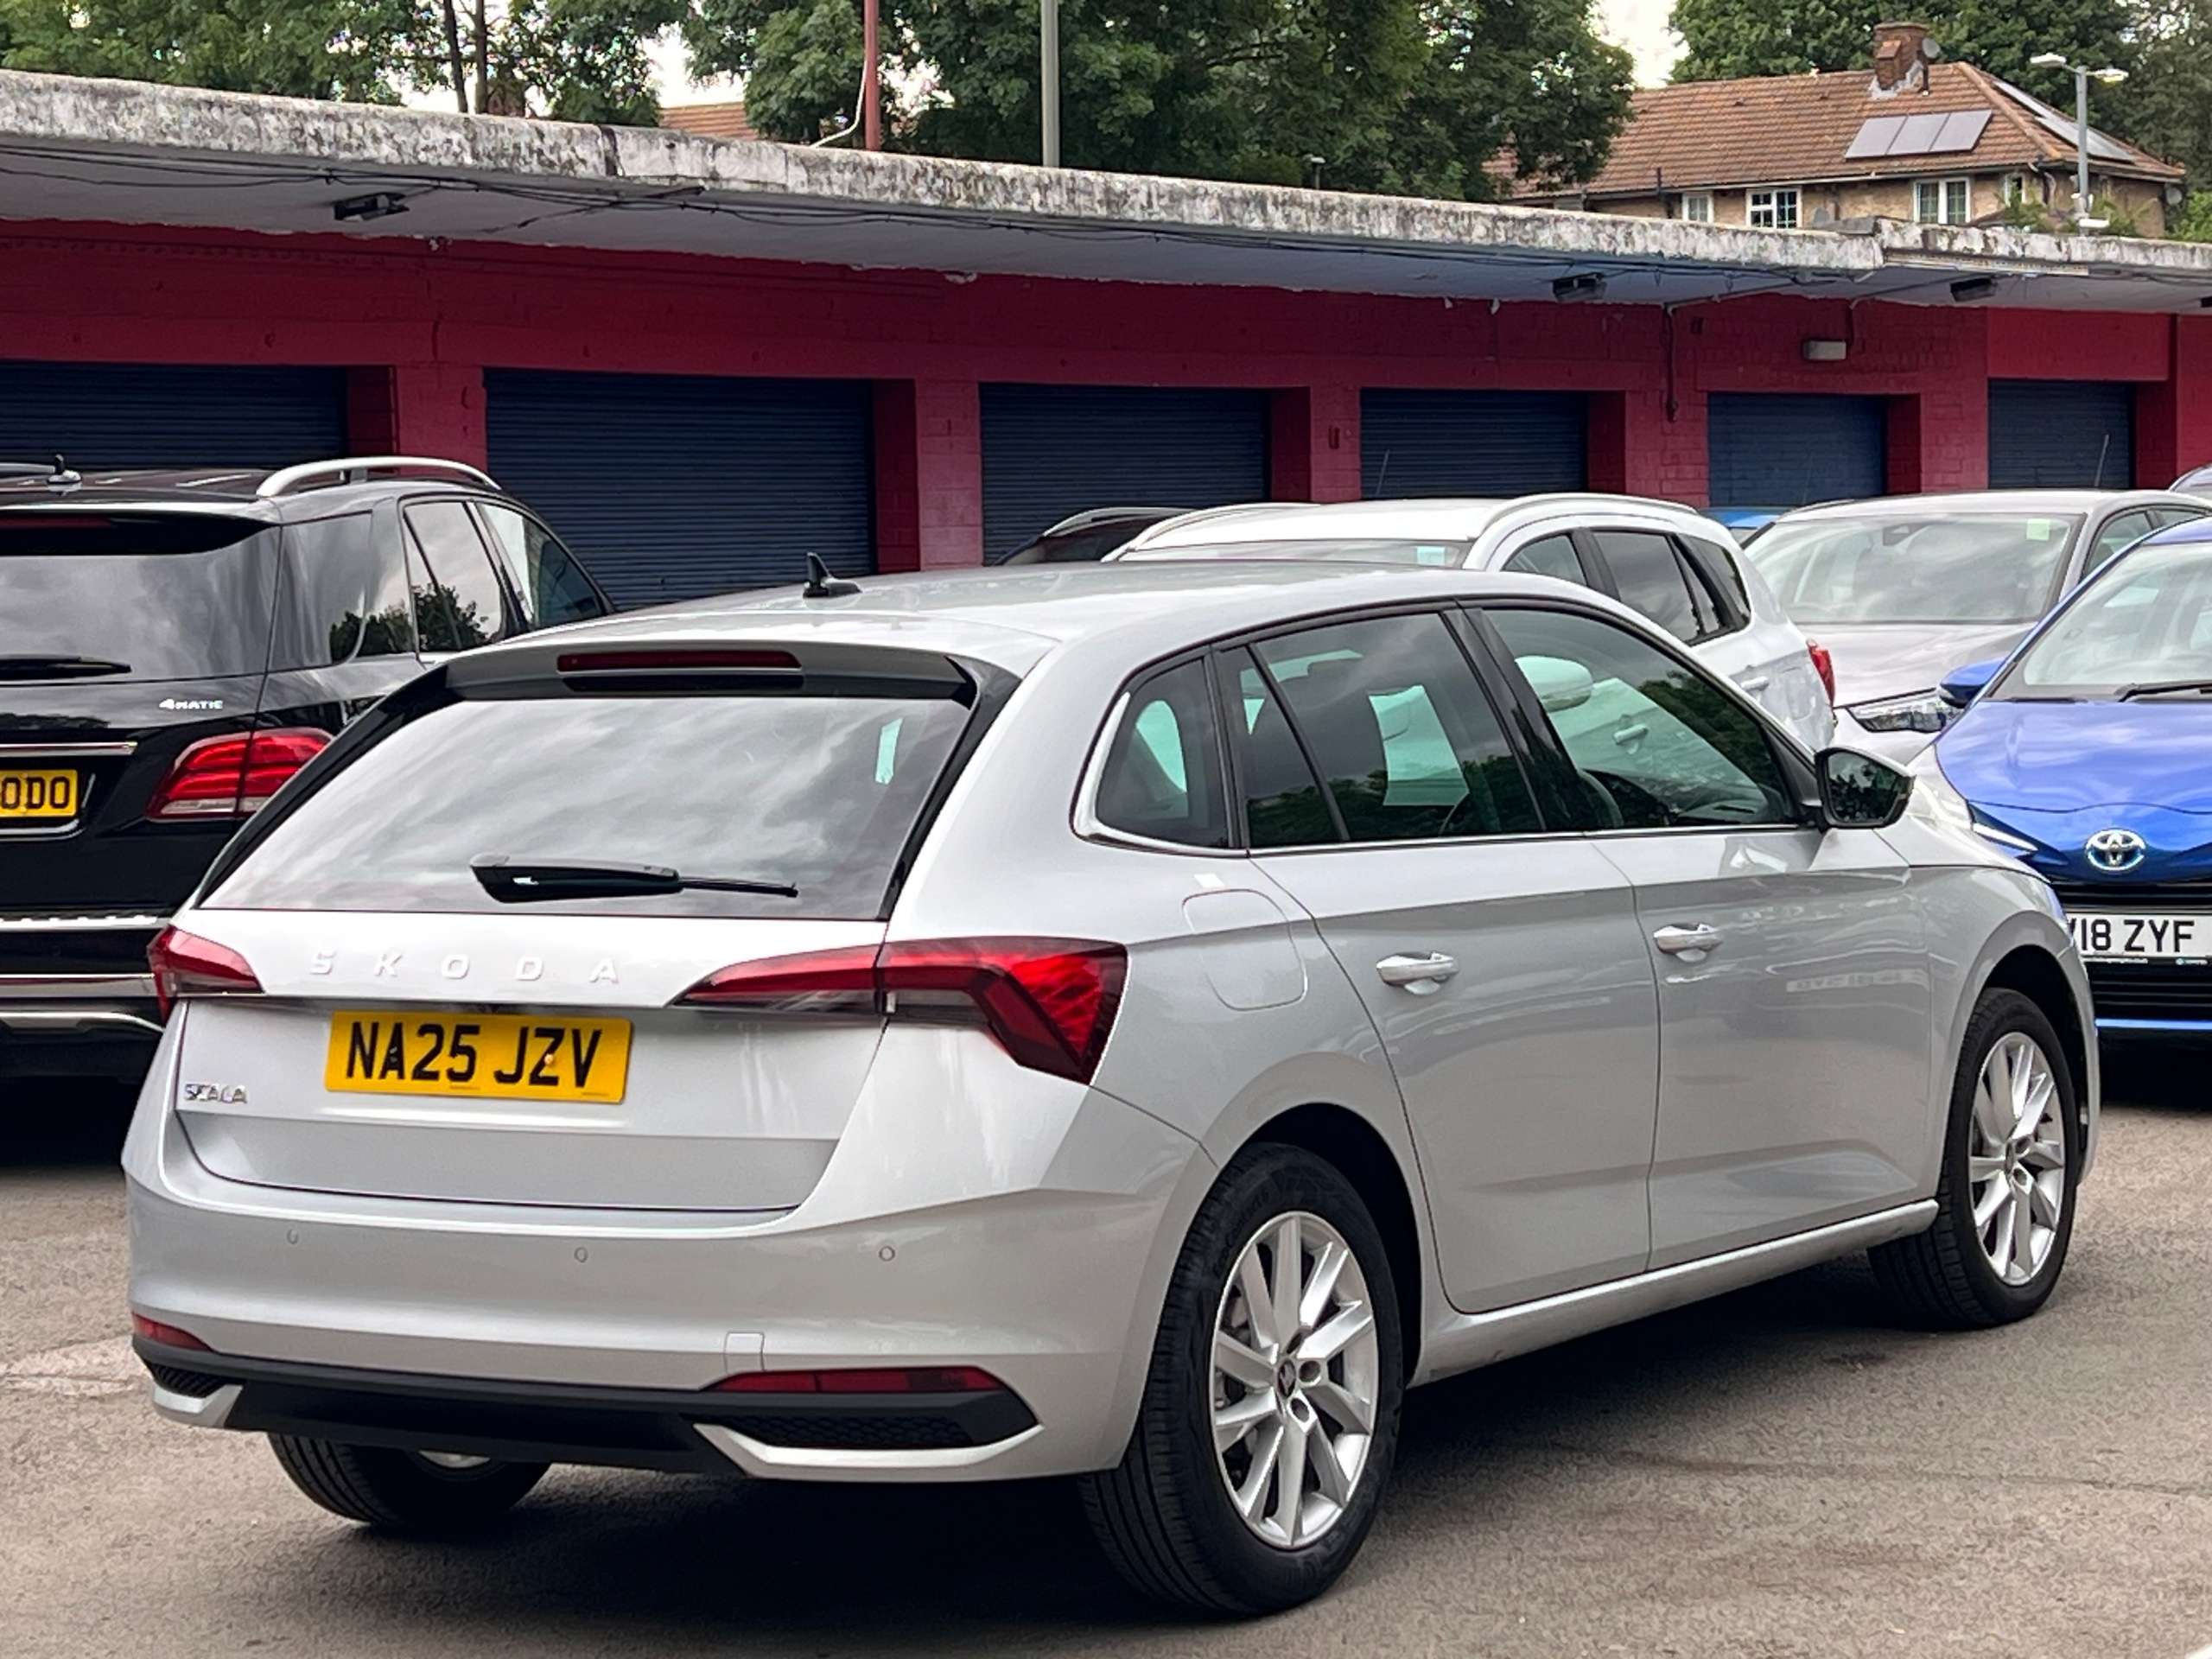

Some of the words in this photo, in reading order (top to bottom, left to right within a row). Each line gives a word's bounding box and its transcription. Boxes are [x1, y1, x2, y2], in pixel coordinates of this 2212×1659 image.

[2123, 919, 2195, 952] ZYF
[346, 1020, 480, 1083] NA25
[493, 1026, 602, 1088] JZV
